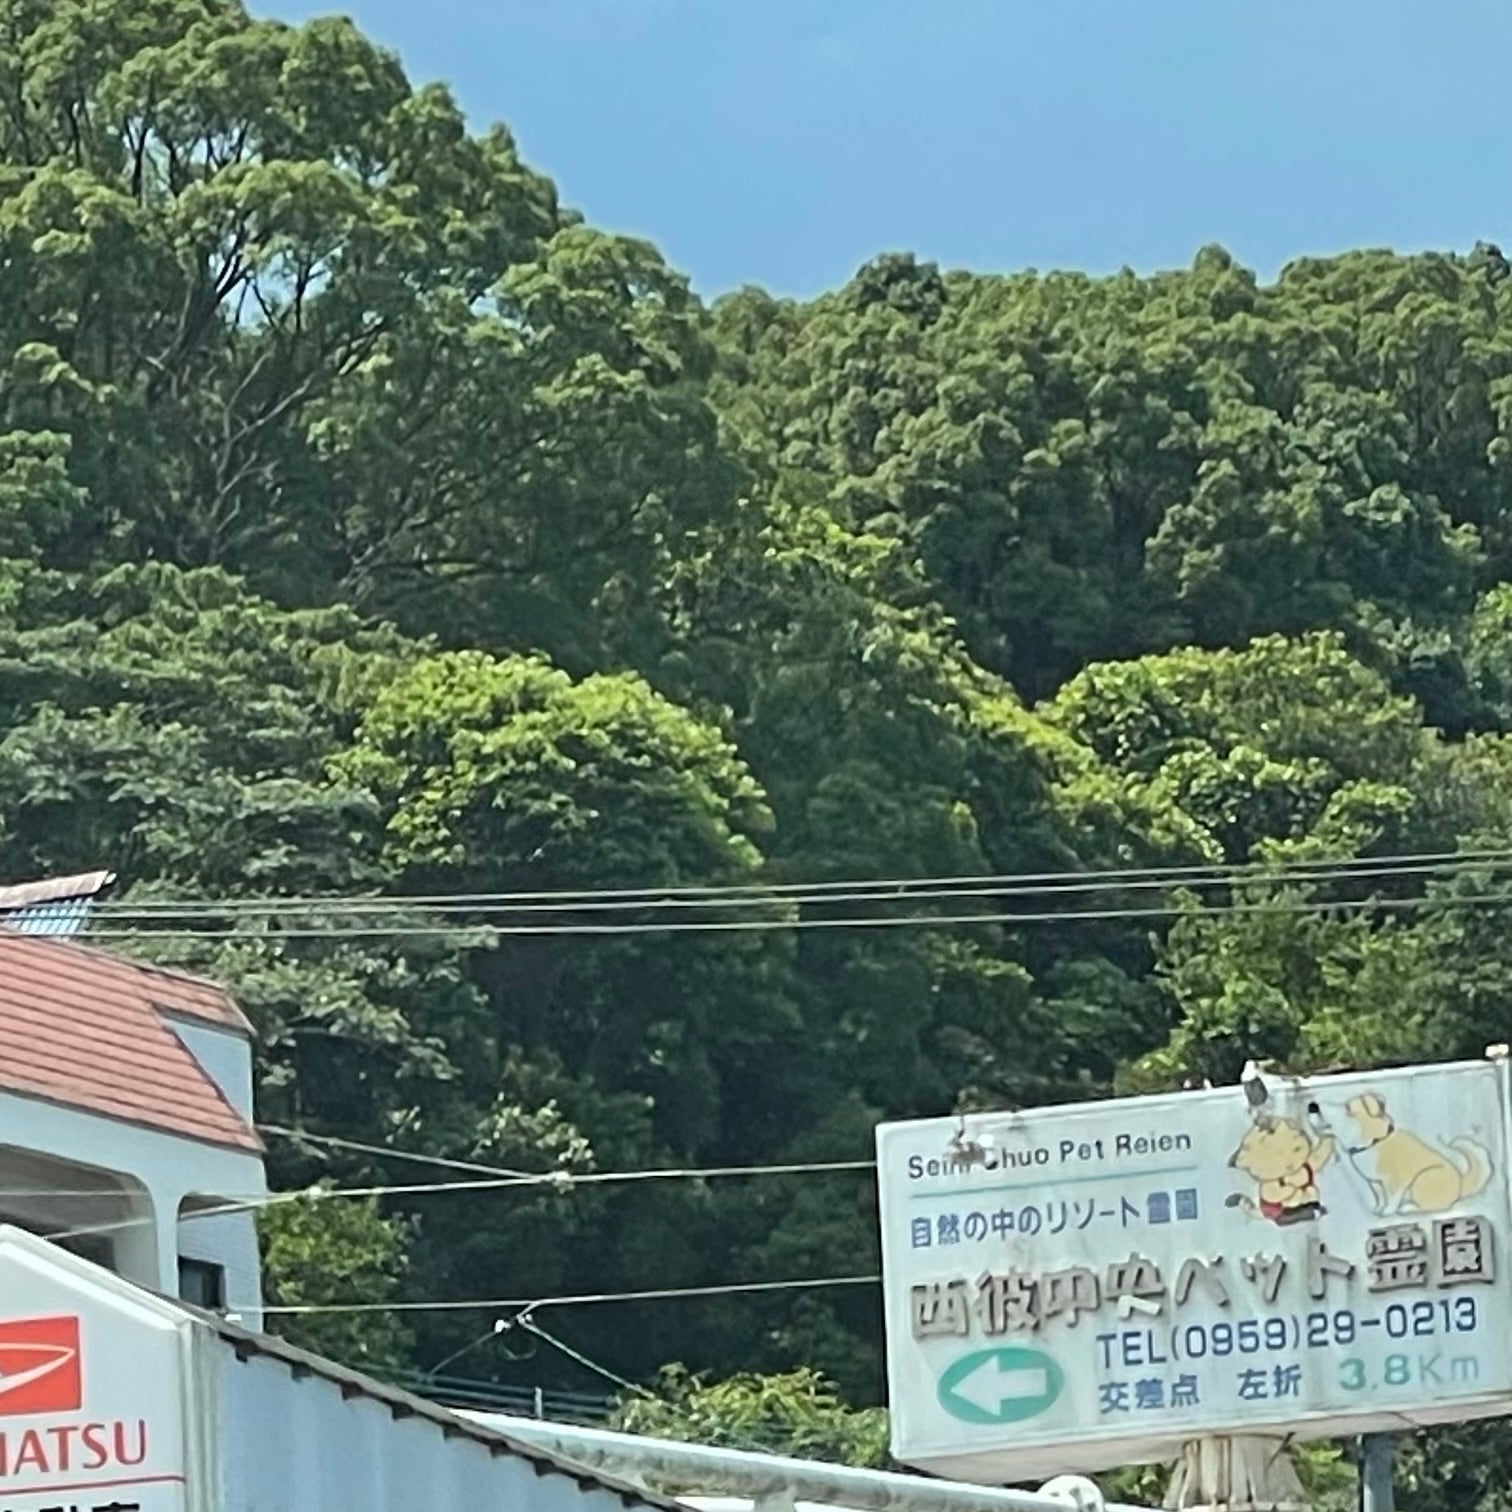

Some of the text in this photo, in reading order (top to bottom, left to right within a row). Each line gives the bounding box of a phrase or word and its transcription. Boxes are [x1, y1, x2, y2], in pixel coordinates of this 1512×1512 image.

[1059, 1140, 1105, 1162] Pet
[1115, 1132, 1192, 1156] Reien
[1098, 1374, 1200, 1414] 交差点
[1237, 1364, 1302, 1399] 左折
